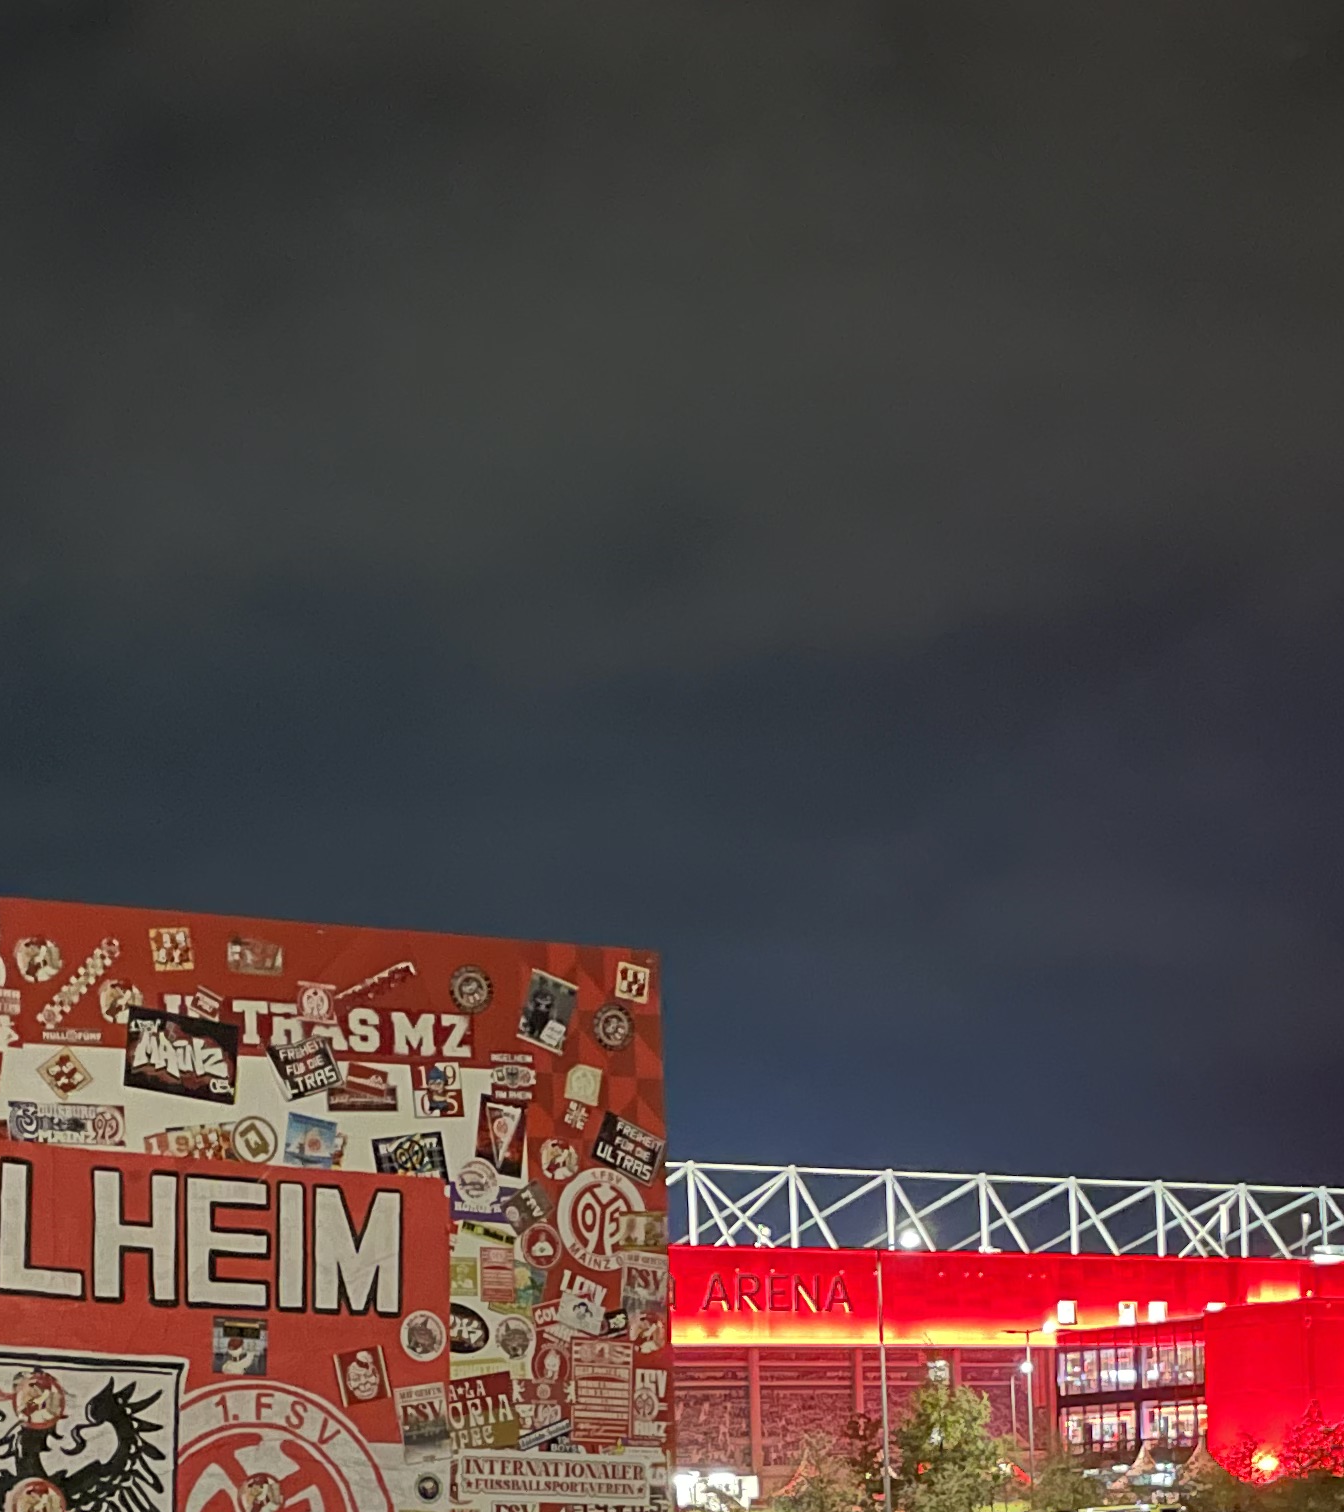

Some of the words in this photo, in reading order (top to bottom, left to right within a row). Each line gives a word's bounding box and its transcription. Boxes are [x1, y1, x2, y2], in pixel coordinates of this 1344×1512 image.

[390, 1011, 472, 1058] MZ
[285, 1066, 337, 1095] LTRAS
[615, 1121, 663, 1151] FREIHEIT
[596, 1141, 653, 1182] ULTRAS
[568, 1241, 611, 1270] MAINZ
[702, 1272, 854, 1313] ARENA
[255, 1392, 341, 1446] FSV
[448, 1393, 514, 1430] ORIA
[464, 1458, 645, 1481] INTERNATIONALER
[474, 1478, 635, 1496] FUSSBALLSPORTVEREIN
